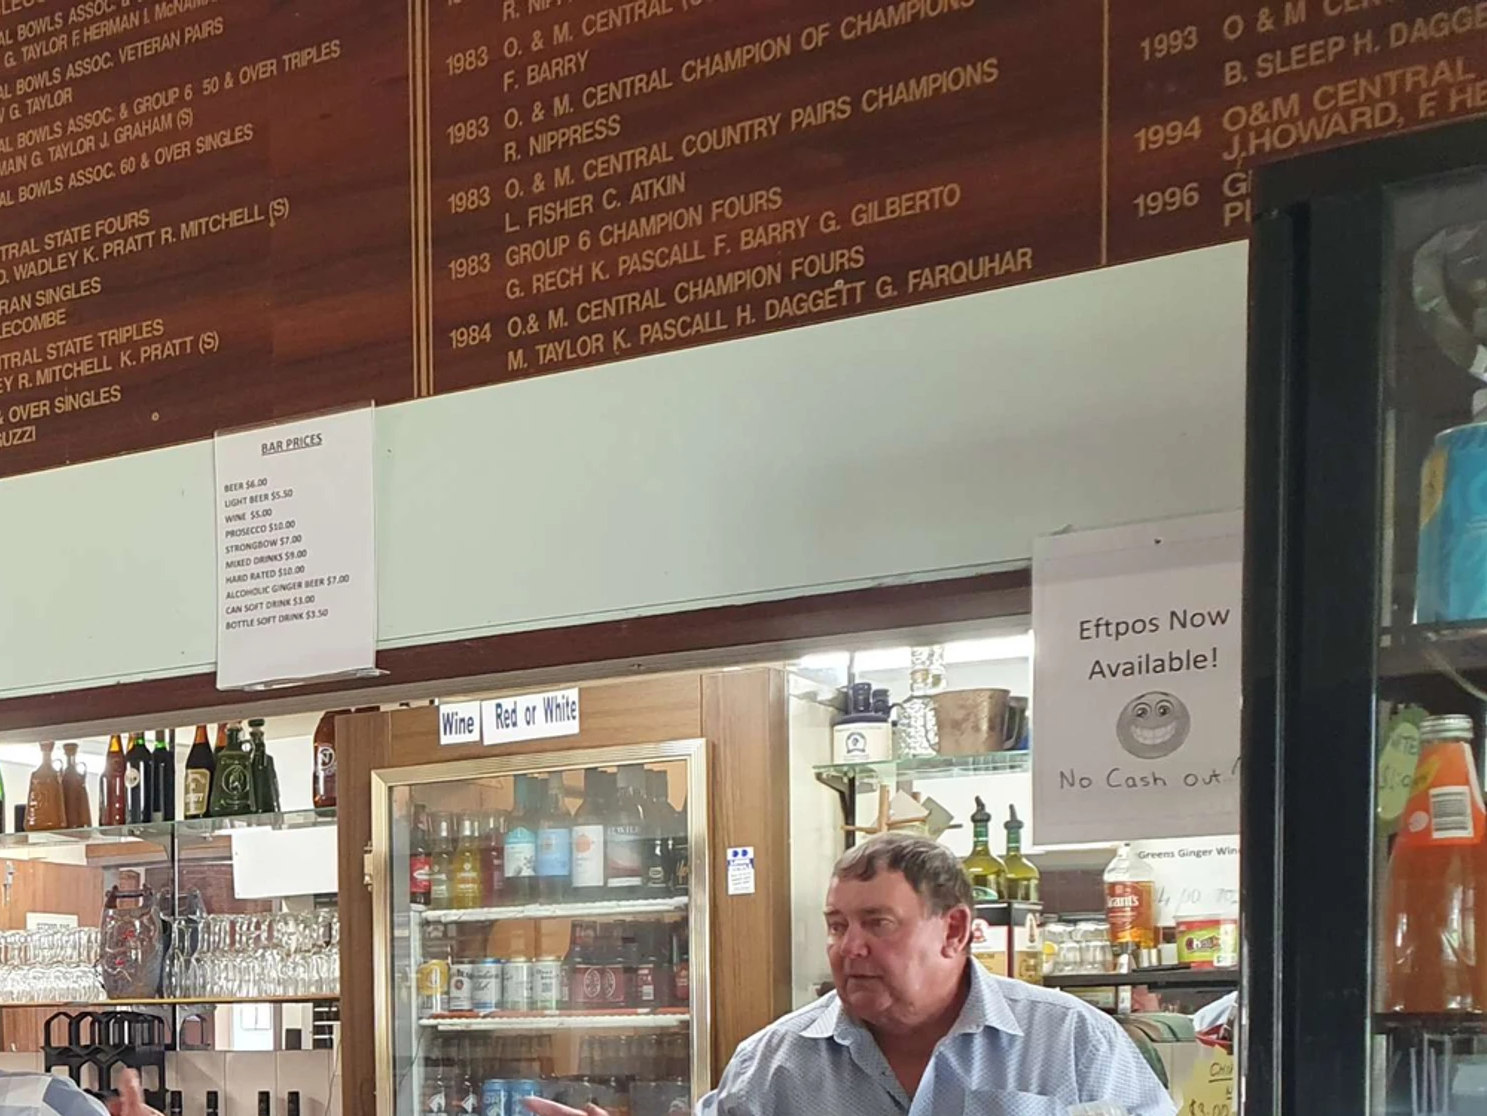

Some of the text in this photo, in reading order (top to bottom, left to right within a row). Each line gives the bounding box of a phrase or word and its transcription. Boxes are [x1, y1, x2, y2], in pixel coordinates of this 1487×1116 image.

[1225, 61, 1247, 86] B.
[1256, 36, 1345, 78] SLEEP
[1354, 30, 1380, 56] H.
[447, 116, 489, 144] 1983
[505, 108, 523, 128] O.
[532, 102, 544, 122] &
[554, 94, 573, 117] M.
[583, 68, 673, 108] CENTRAL
[682, 34, 790, 82] CHAMPION
[801, 23, 829, 50] OF
[1223, 58, 1475, 131] O&M CENTRAL
[448, 58, 998, 213] 1983 O. & M. CENTRAL COUNTRY PAIRS CHAMPIONS
[1134, 116, 1201, 151] 1994
[1133, 183, 1199, 217] 1996
[45, 224, 91, 250] STATE
[96, 210, 149, 237] FOURS
[506, 184, 960, 299] G. RECH K. PASCALL F. BARRY G. GILBERTO
[36, 278, 101, 306] SINGLES
[449, 246, 864, 348] 1984 O.& M. CENTRAL CHAMPION FOURS
[508, 248, 1032, 370] M. TAYLOR K. PASCALL H. DAGGETT G. FARQUHAR
[261, 433, 323, 454] BAR PRICES
[224, 478, 267, 492] BEER $6.00
[225, 489, 293, 508] LIGHT BEER $5.50
[225, 508, 272, 523] WINE $5.00
[225, 520, 295, 538] PROSECCO $10.00
[225, 534, 301, 554] STRONGBOW $7.00
[226, 549, 307, 568] MIXED DRINKS $9.00
[226, 565, 306, 583] HARD RATED $10.00
[226, 574, 349, 599] ALCOHOLIC GINGER BEER $7.00
[226, 595, 315, 614] CAN SOFT DRINK $3.00
[226, 609, 328, 630] BOTTLE SOFT DRINK $3.50
[1079, 609, 1230, 641] Eftpos Now
[1088, 648, 1217, 680] Available!
[442, 712, 474, 735] Wine
[495, 695, 577, 730] Red or White
[1059, 769, 1091, 789] No
[1106, 768, 1166, 788] Cash
[1138, 851, 1175, 859] Greens
[1178, 848, 1213, 858] Ginger
